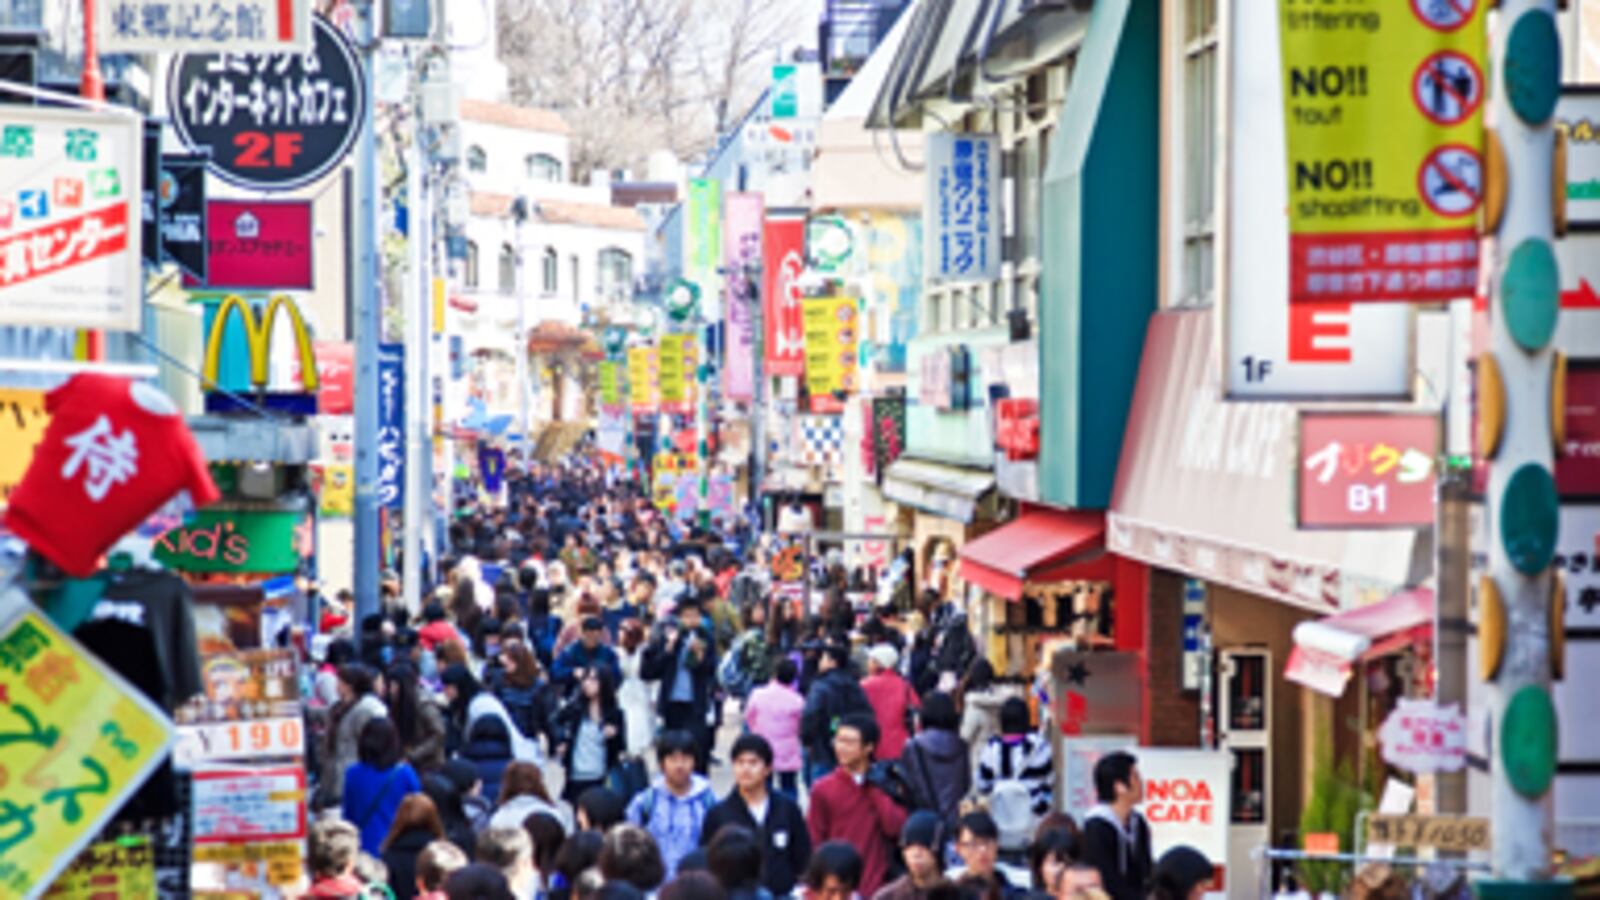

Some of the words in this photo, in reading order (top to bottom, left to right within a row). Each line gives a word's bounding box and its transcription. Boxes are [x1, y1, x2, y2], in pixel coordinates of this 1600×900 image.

[1291, 65, 1369, 97] NO!!
[183, 77, 348, 125] インターネットカフェ
[233, 131, 304, 168] 2F
[1295, 159, 1374, 191] NO!!
[1298, 196, 1420, 219] shoplifting
[1241, 357, 1272, 382] 1F
[61, 414, 139, 502] 侍
[1348, 484, 1387, 512] B1
[227, 721, 300, 752] 190
[1145, 779, 1213, 801] NOA
[1146, 804, 1213, 823] CAFE
